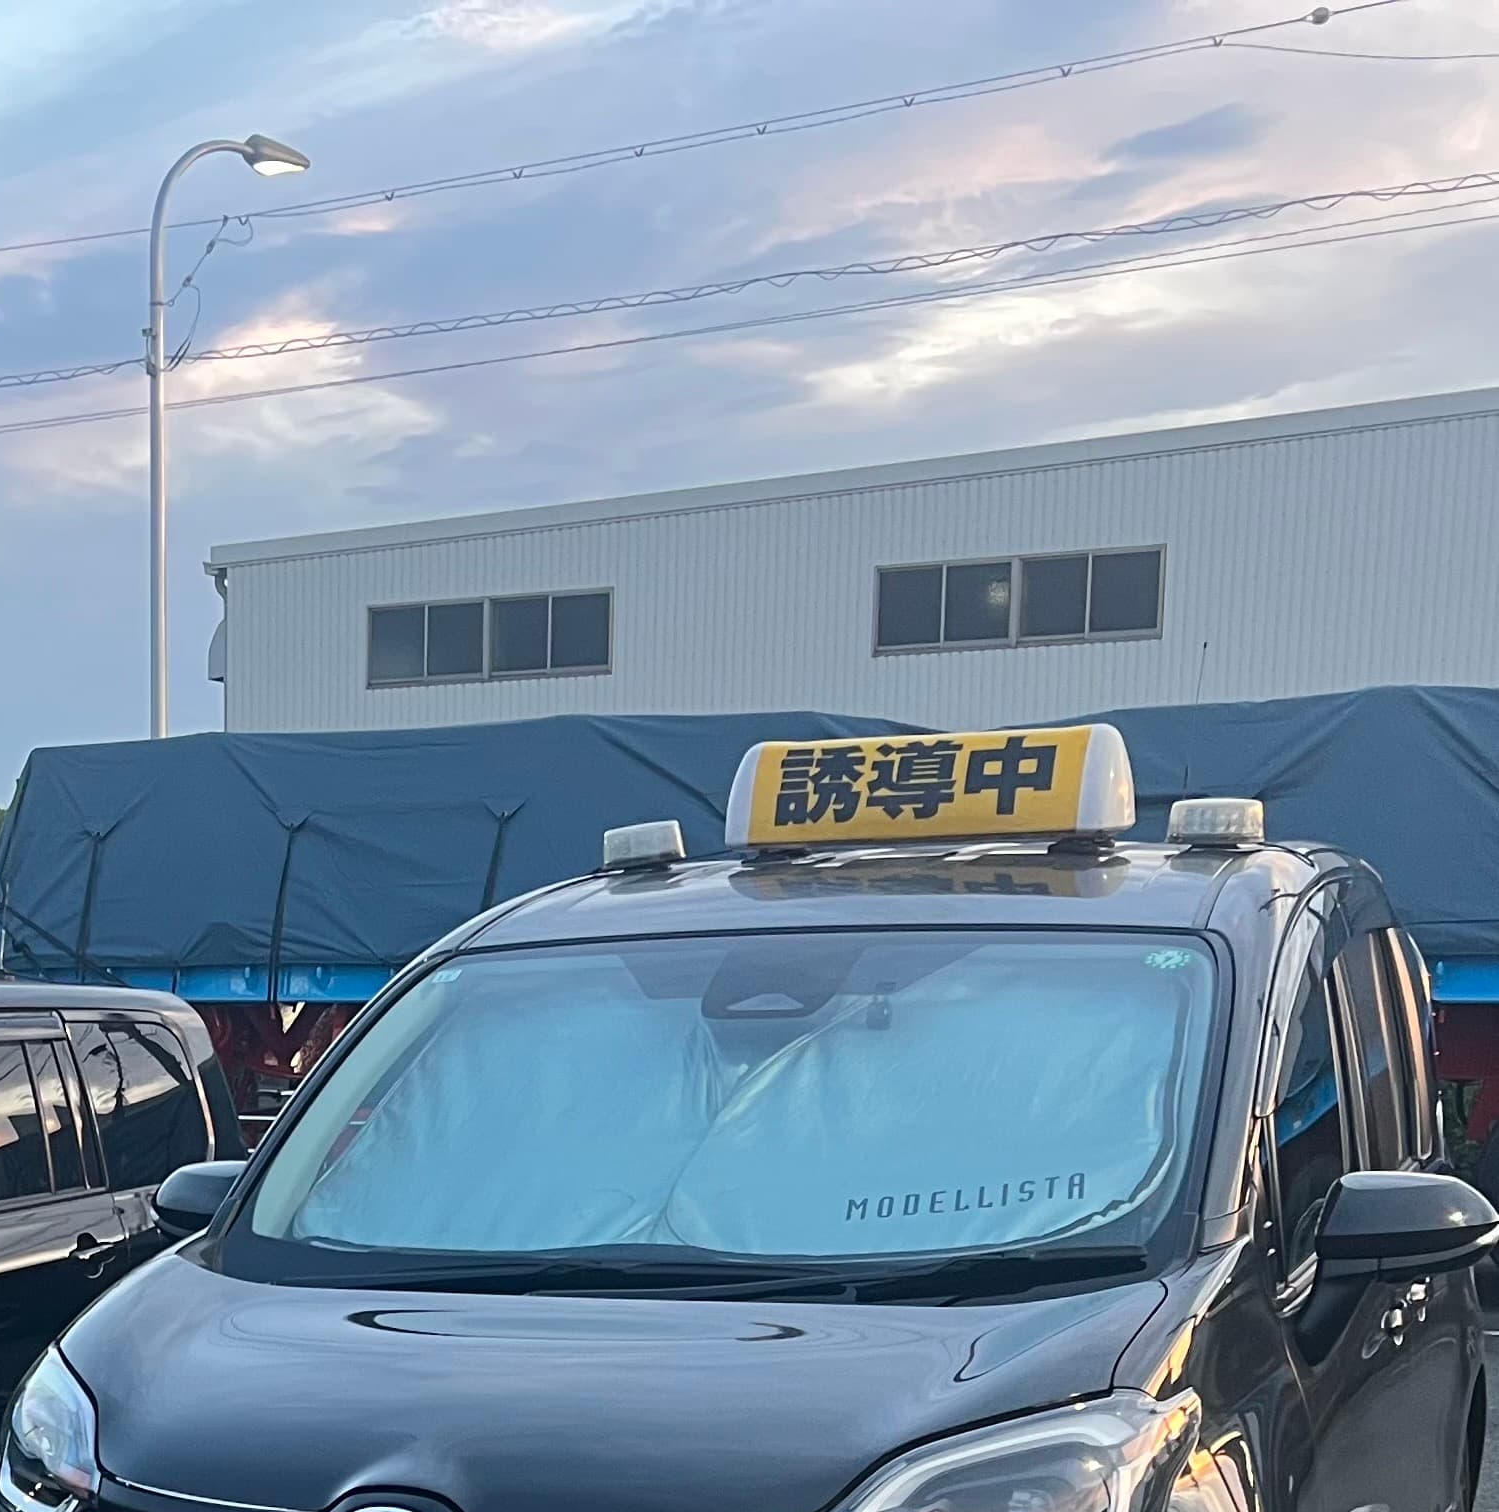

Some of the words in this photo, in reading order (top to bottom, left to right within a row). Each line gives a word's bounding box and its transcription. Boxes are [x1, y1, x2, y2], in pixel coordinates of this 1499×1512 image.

[773, 736, 1057, 827] 誘導中
[845, 1172, 1086, 1221] MODELLISTA
